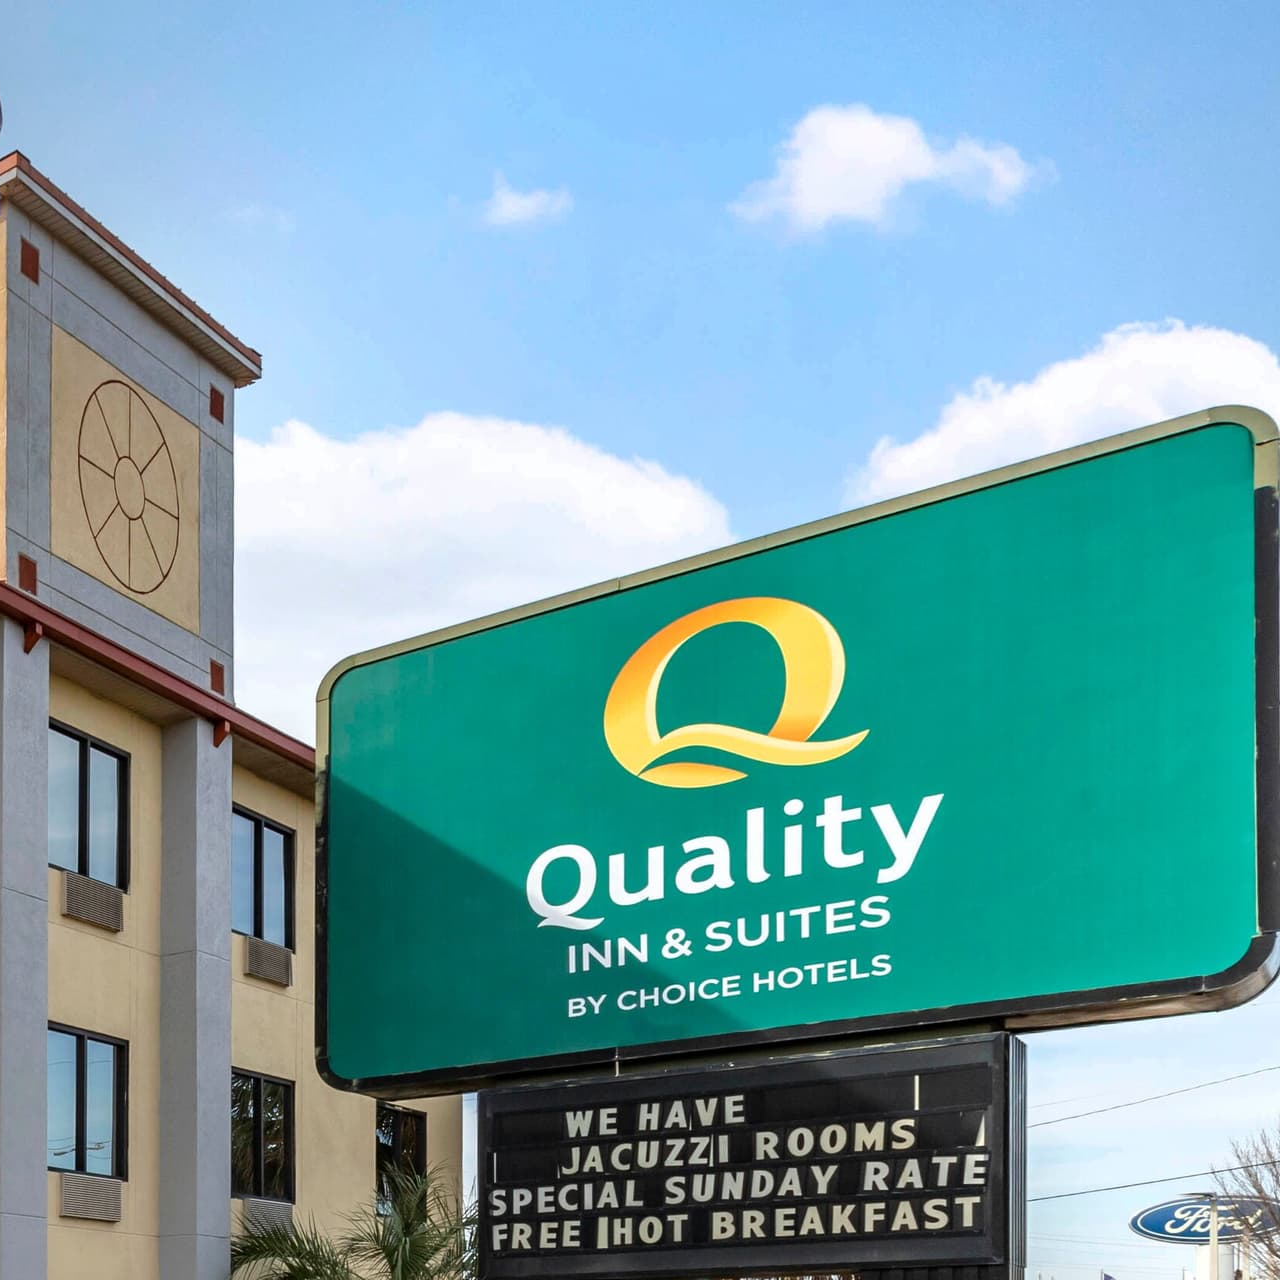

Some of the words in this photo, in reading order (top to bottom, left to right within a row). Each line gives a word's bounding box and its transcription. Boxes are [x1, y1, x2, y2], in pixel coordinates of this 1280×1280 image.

[526, 794, 944, 930] Quality
[568, 934, 648, 974] INN
[661, 928, 692, 960] &
[705, 895, 892, 952] SUITES
[568, 994, 607, 1018] BY
[617, 975, 741, 1011] CHOICE
[753, 954, 892, 993] HOTELS
[561, 1134, 729, 1175] JACUZZI
[755, 1119, 916, 1160] ROOMS
[565, 1107, 618, 1138] WE
[639, 1095, 745, 1131] HAVE
[490, 1179, 644, 1217] SPECIAL
[665, 1165, 838, 1205] SUNDAY
[863, 1154, 989, 1191] RATE
[492, 1220, 581, 1250] FREE
[613, 1214, 688, 1245] HOT
[712, 1196, 981, 1240] BREAKFAST
